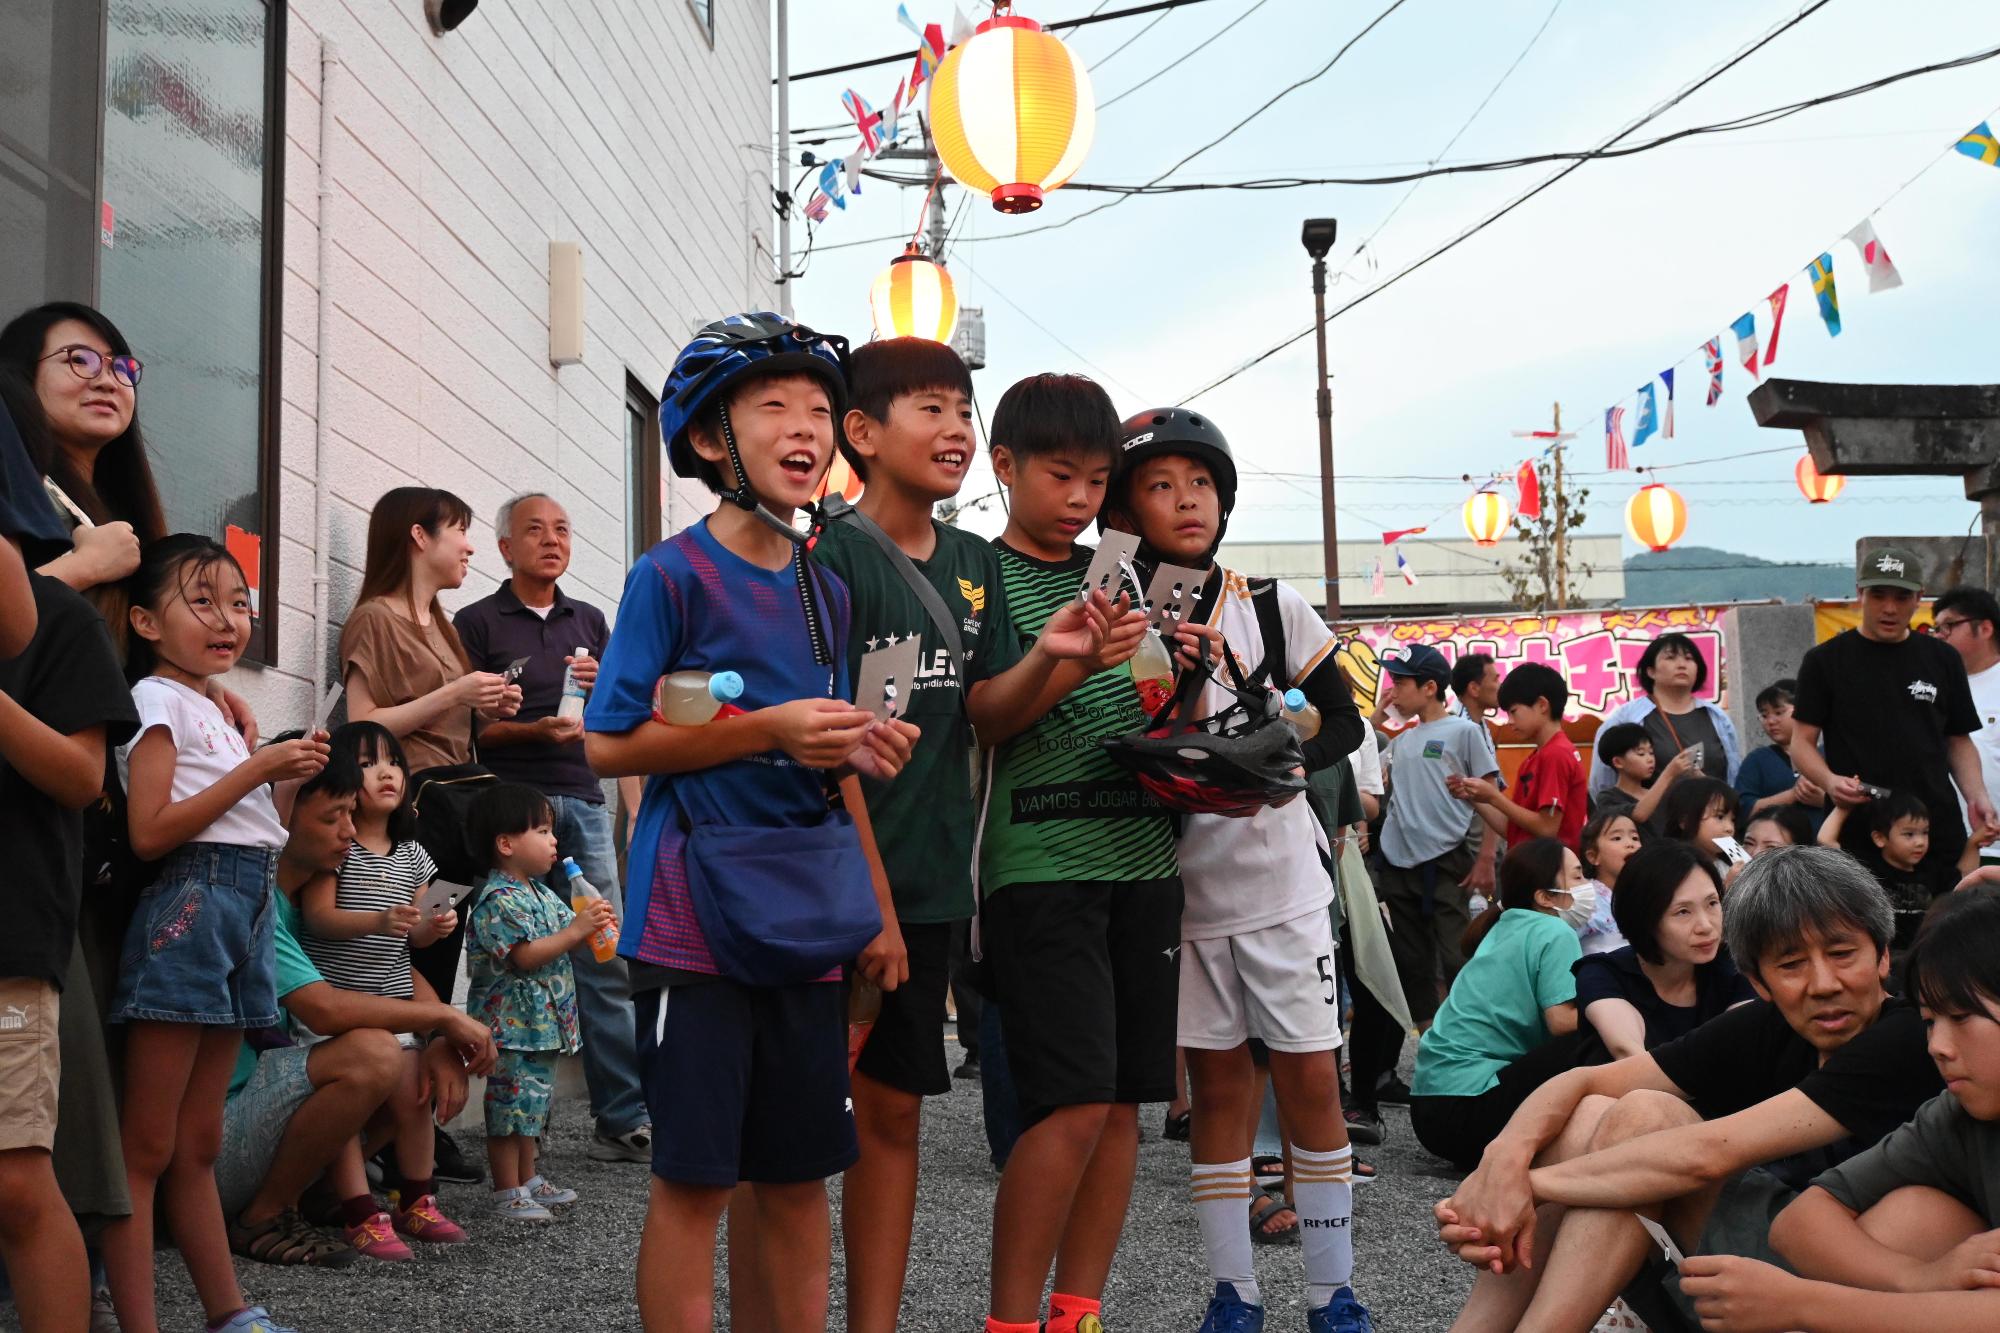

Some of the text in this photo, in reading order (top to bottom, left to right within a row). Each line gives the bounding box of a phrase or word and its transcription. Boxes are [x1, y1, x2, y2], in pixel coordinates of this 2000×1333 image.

[1601, 608, 1718, 631] 大人気!
[1072, 702, 1107, 721] Por
[1035, 730, 1098, 753] Todos
[1018, 791, 1081, 813] VAMOS
[1087, 790, 1138, 808] JOGAR
[1316, 954, 1335, 1005] 5
[1303, 1216, 1350, 1229] RMCF
